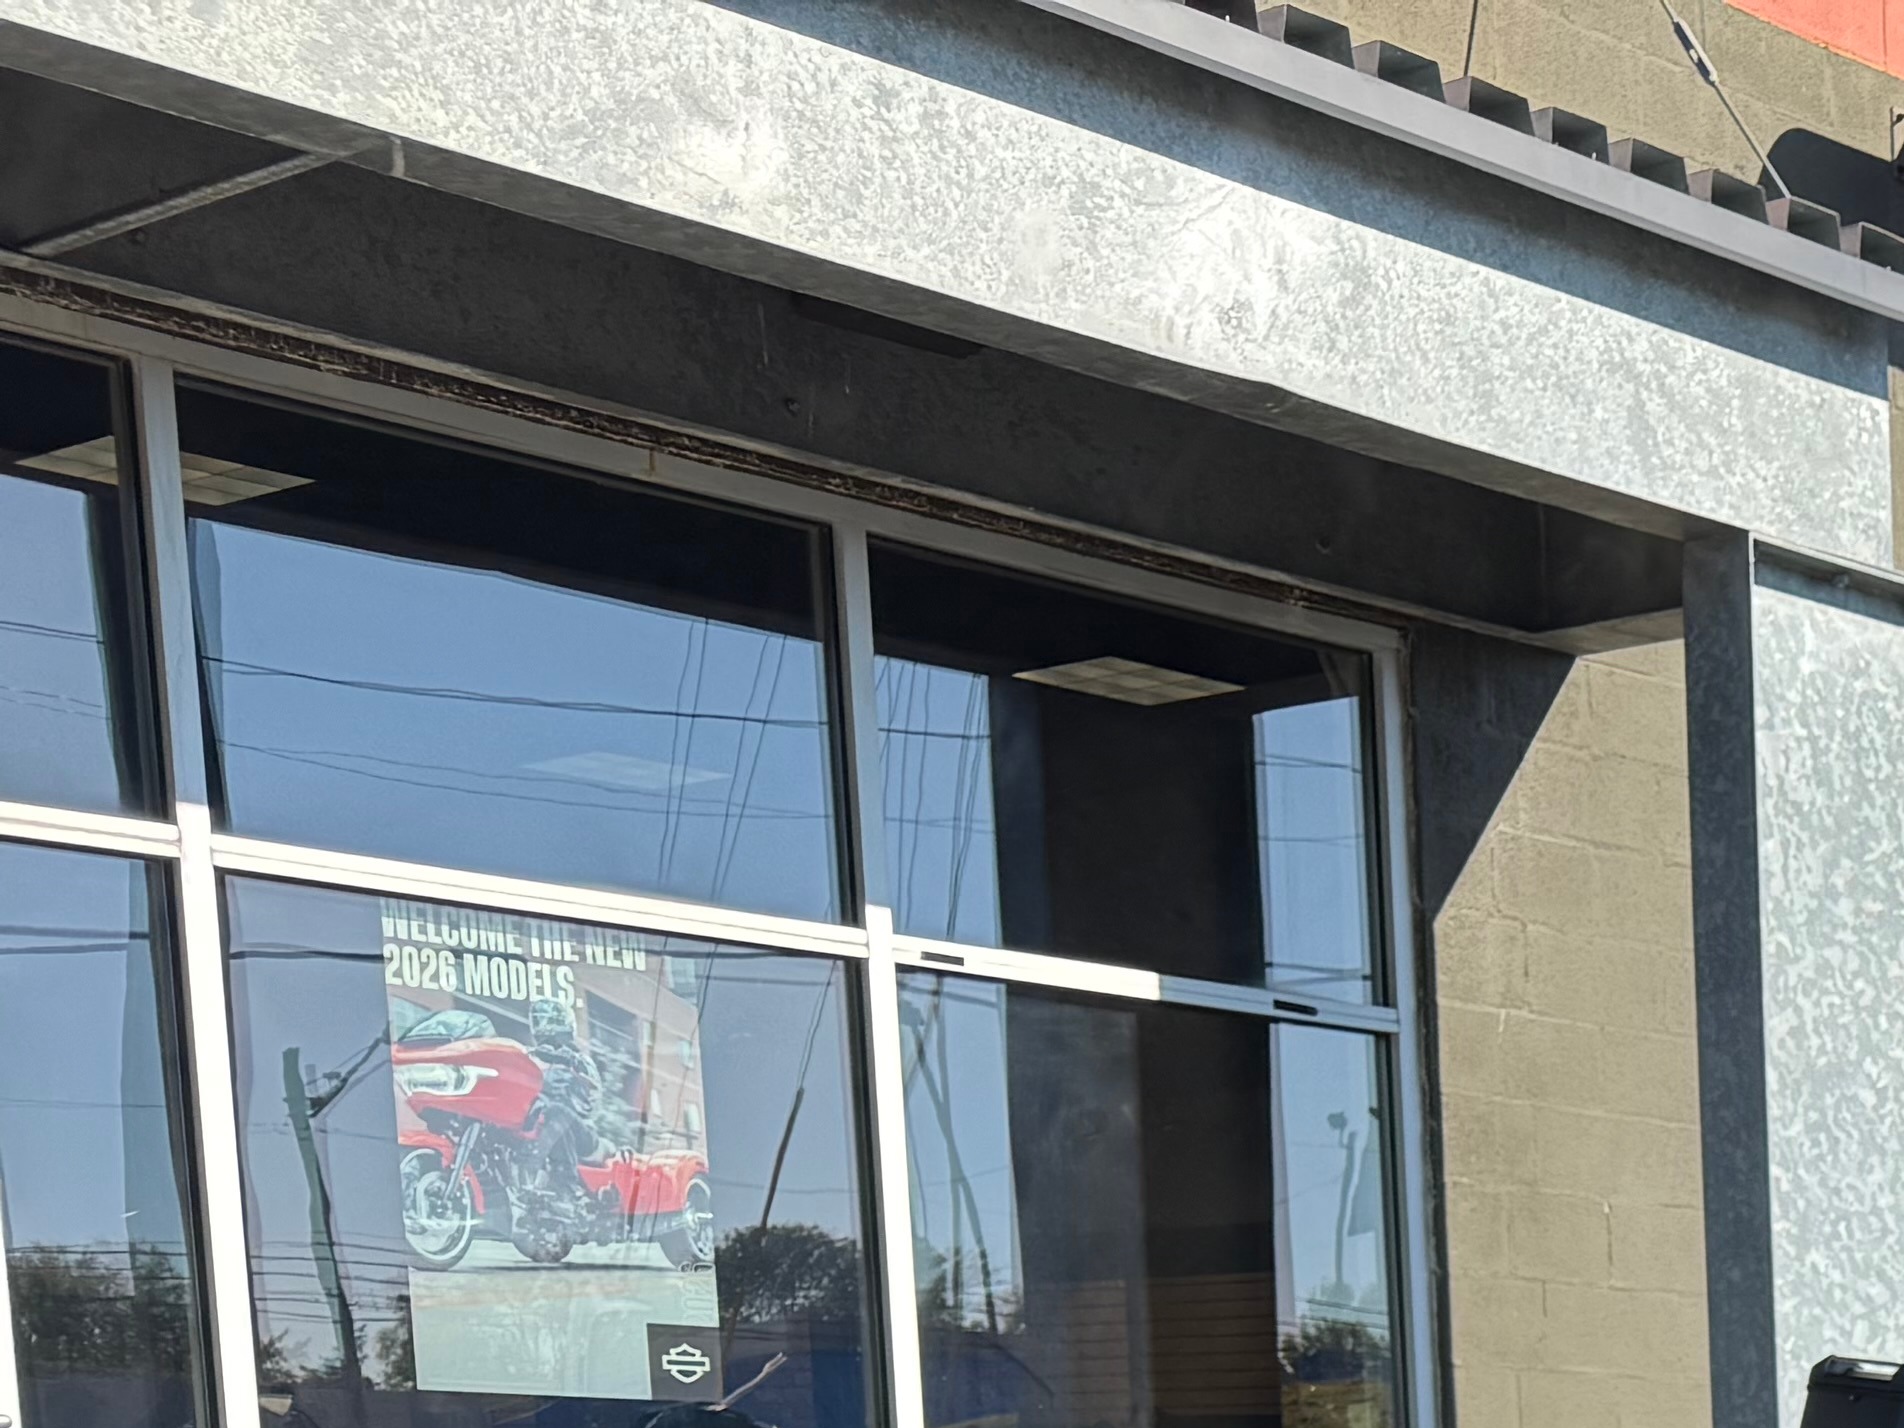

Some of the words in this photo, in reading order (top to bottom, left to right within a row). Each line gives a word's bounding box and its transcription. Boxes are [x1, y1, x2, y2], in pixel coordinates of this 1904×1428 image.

[381, 898, 524, 956] WELCOME
[530, 915, 580, 962] THE
[585, 926, 647, 972] NEW
[383, 943, 458, 993] 2026
[463, 952, 584, 1010] MODELS.
